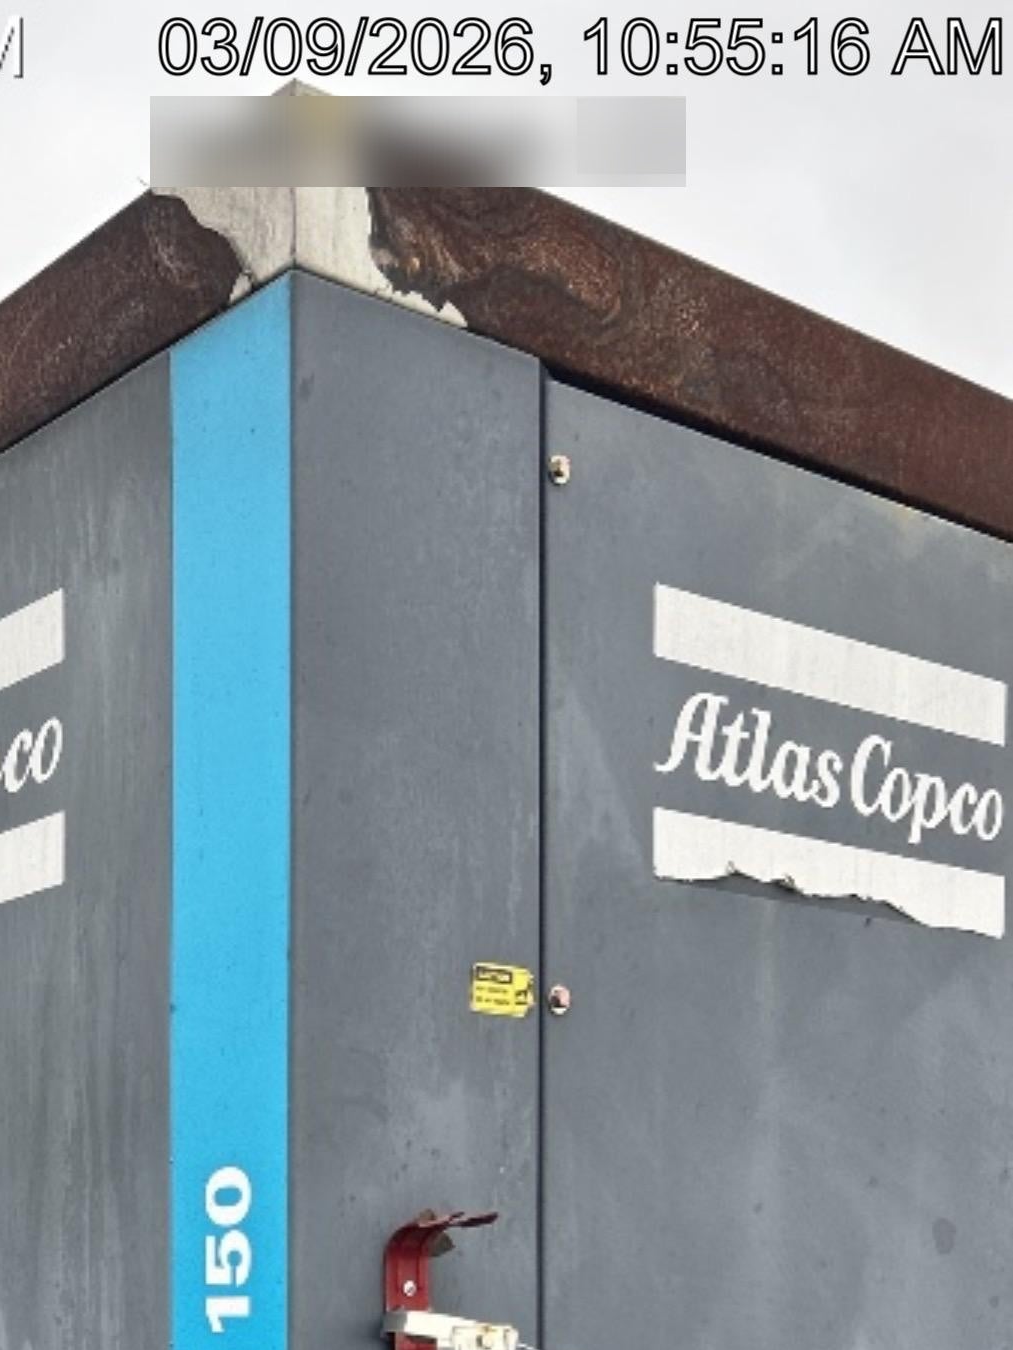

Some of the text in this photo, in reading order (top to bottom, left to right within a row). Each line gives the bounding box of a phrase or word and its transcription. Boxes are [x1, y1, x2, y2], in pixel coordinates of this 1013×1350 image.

[653, 692, 1004, 844] Atlas Copco
[204, 1165, 252, 1334] 150
